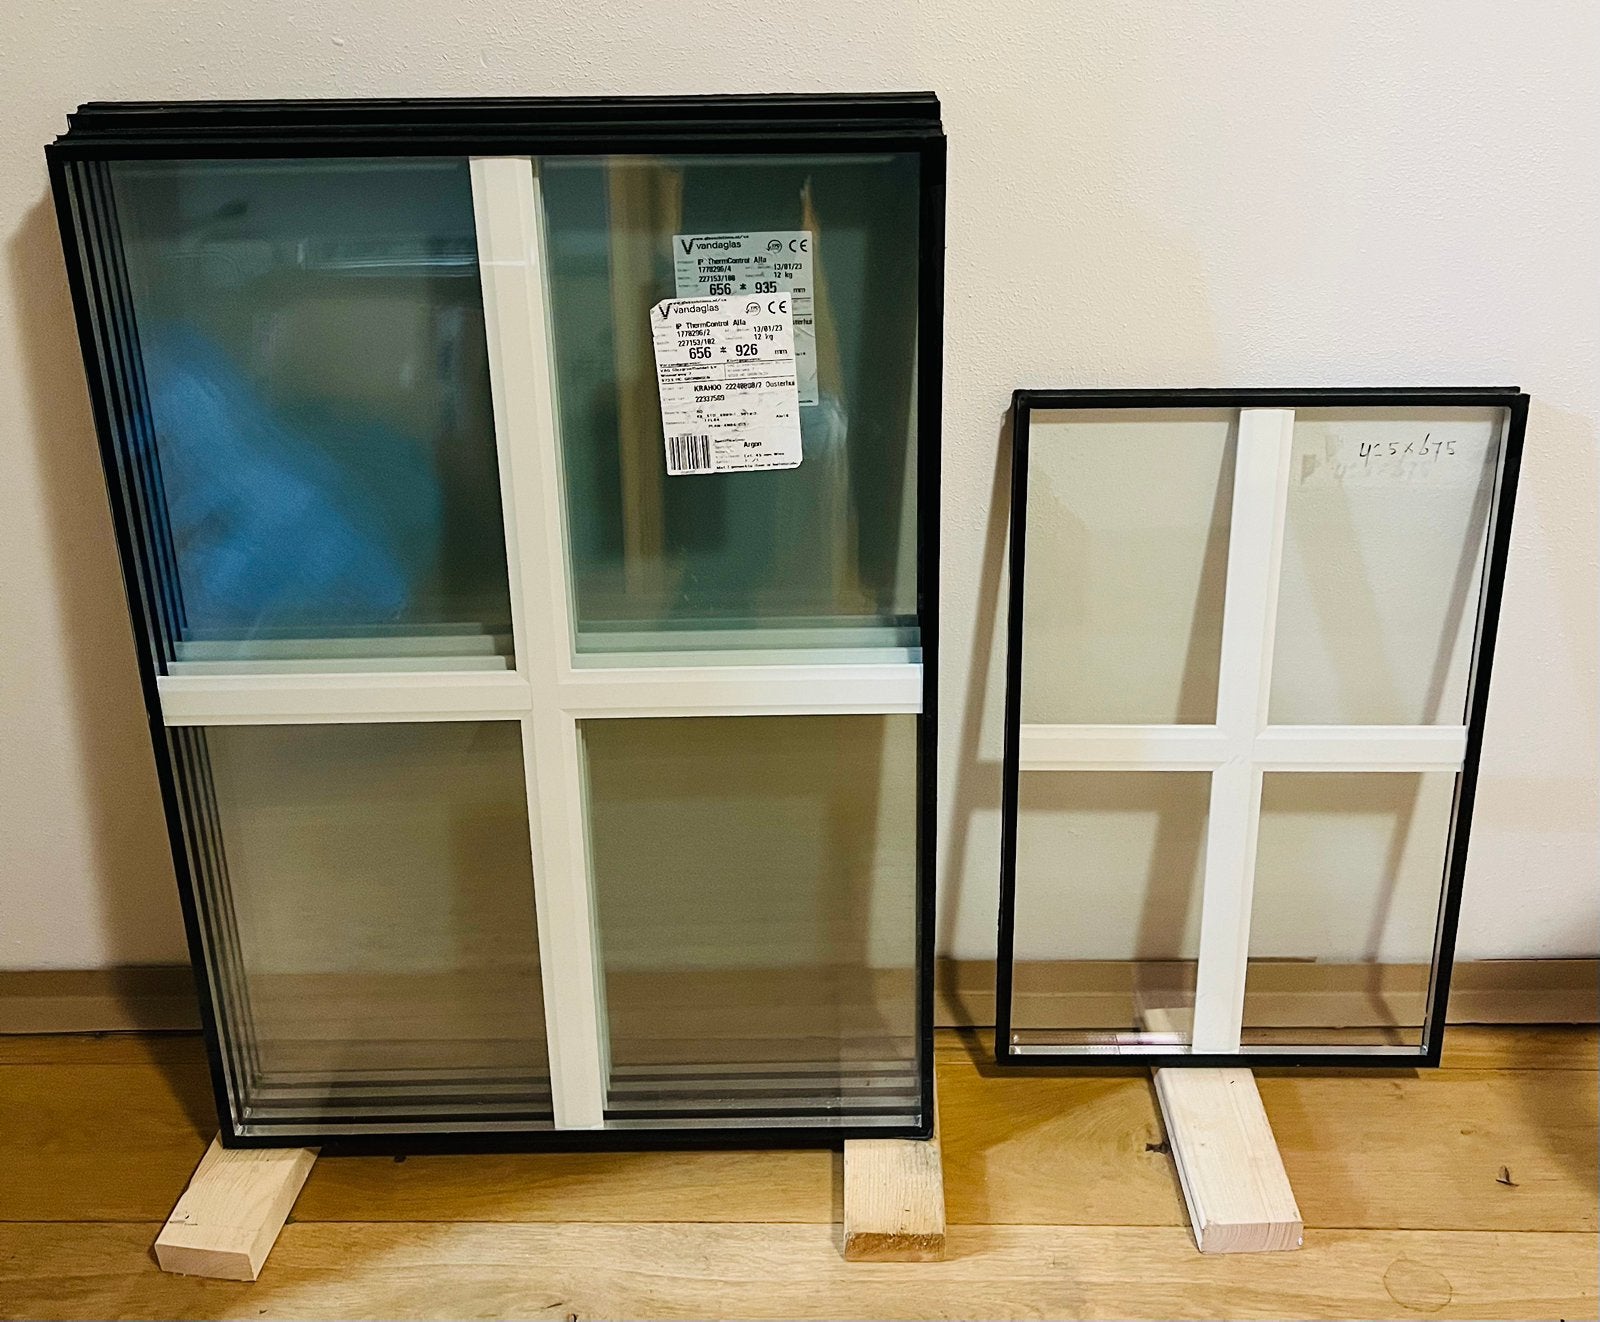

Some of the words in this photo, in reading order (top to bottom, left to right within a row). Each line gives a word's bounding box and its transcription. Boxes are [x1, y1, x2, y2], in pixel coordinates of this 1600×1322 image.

[696, 240, 742, 251] vandaglas
[709, 283, 732, 296] 656
[755, 281, 778, 294] 935
[673, 303, 720, 315] vandaglas
[754, 333, 762, 341] 12
[689, 346, 712, 360] 656
[735, 343, 758, 357] 926
